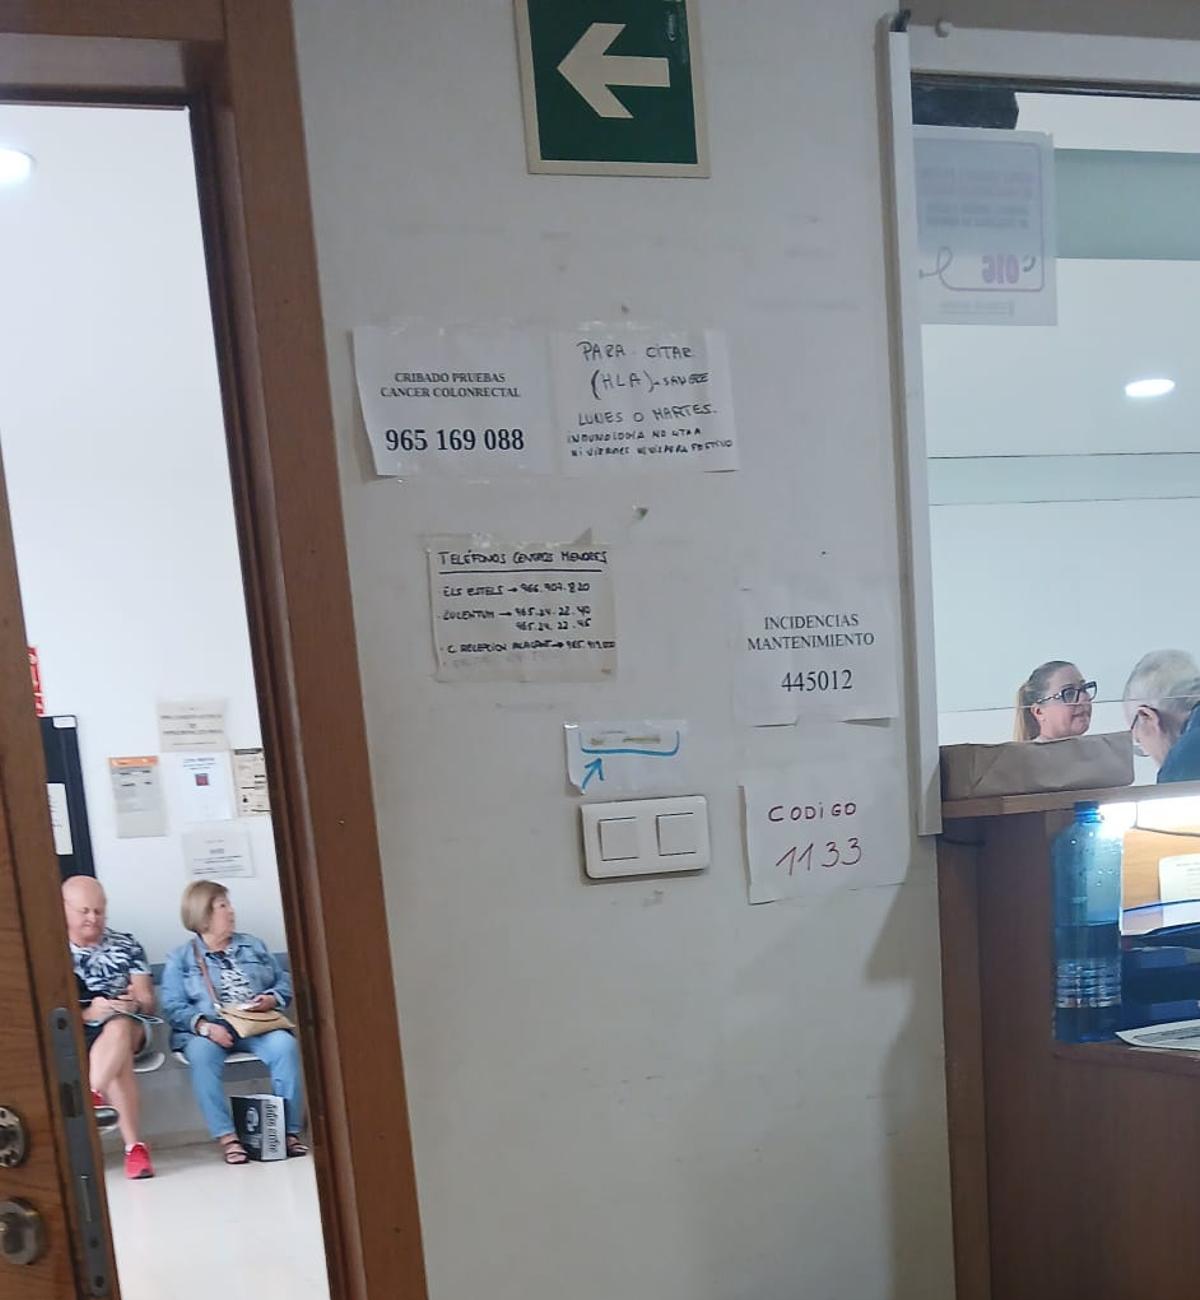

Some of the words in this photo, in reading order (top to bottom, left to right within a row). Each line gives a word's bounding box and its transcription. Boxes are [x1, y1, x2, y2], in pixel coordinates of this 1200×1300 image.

[576, 341, 626, 361] PARA
[394, 372, 449, 384] CRIBADO
[452, 372, 506, 384] PRUEBAS
[380, 386, 431, 399] CANCER
[433, 386, 521, 399] COLONRECTAL
[578, 411, 624, 426] LUNES
[633, 411, 645, 423] O
[385, 428, 429, 452] 965
[436, 428, 476, 451] 169
[484, 428, 525, 451] 088
[513, 551, 554, 564] CENTROS
[561, 550, 608, 565] MENORES
[764, 613, 859, 631] INCIDENCIAS
[748, 631, 875, 651] MANTENIMIENTO
[781, 669, 853, 692] 445012
[775, 837, 862, 876] 1133
